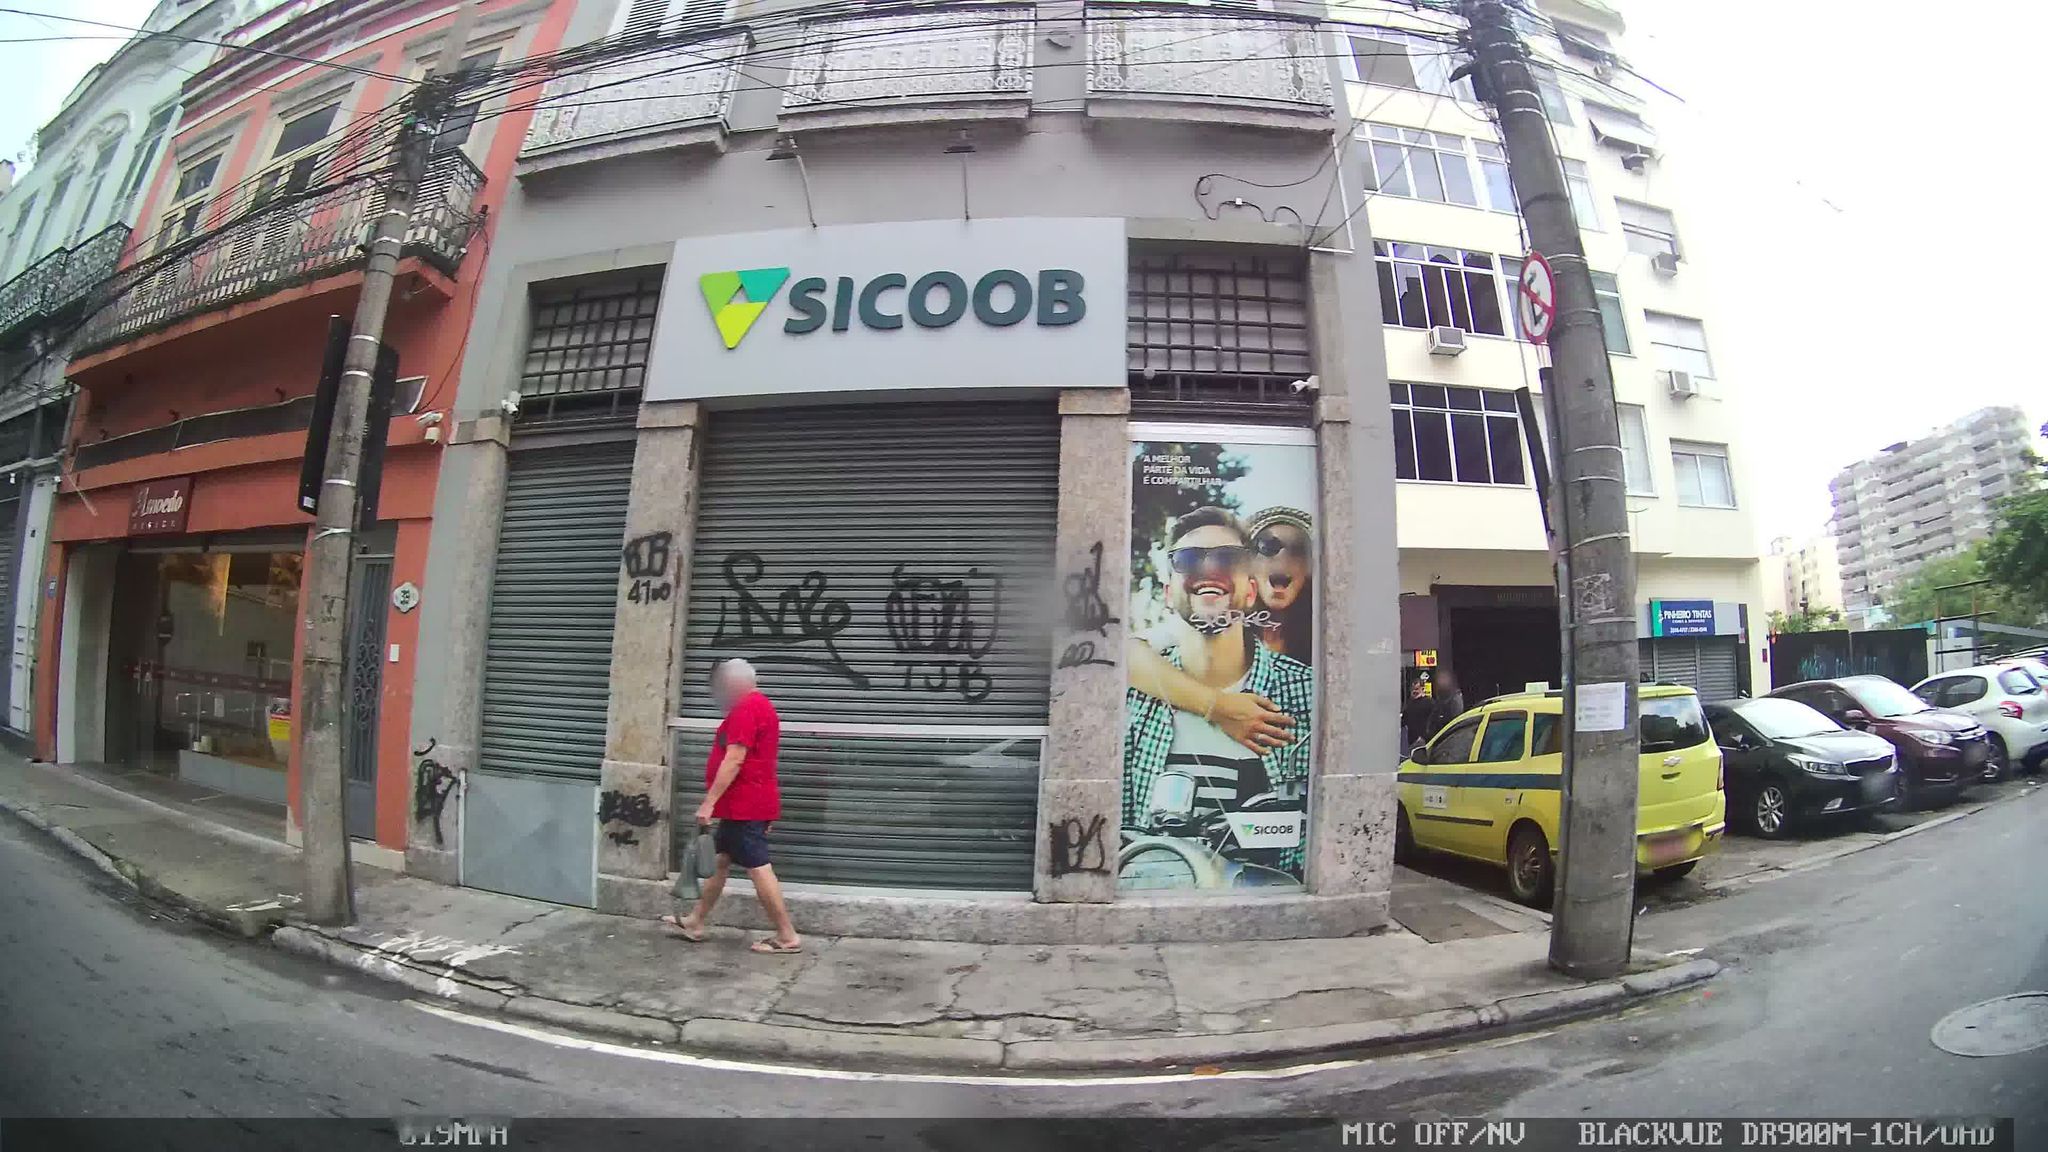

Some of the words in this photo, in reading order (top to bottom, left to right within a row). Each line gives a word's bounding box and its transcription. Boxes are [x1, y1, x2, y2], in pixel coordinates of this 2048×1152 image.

[784, 269, 1087, 334] SICOOB
[1143, 455, 1151, 463] A
[1152, 454, 1191, 463] MELHOR
[1143, 465, 1173, 474] PARTE
[1174, 466, 1187, 474] DA
[1188, 466, 1211, 475] VIDA
[1150, 476, 1223, 486] COMPARTILHAR
[1692, 610, 1712, 619] TINTAS
[1253, 825, 1294, 835] SICOOB
